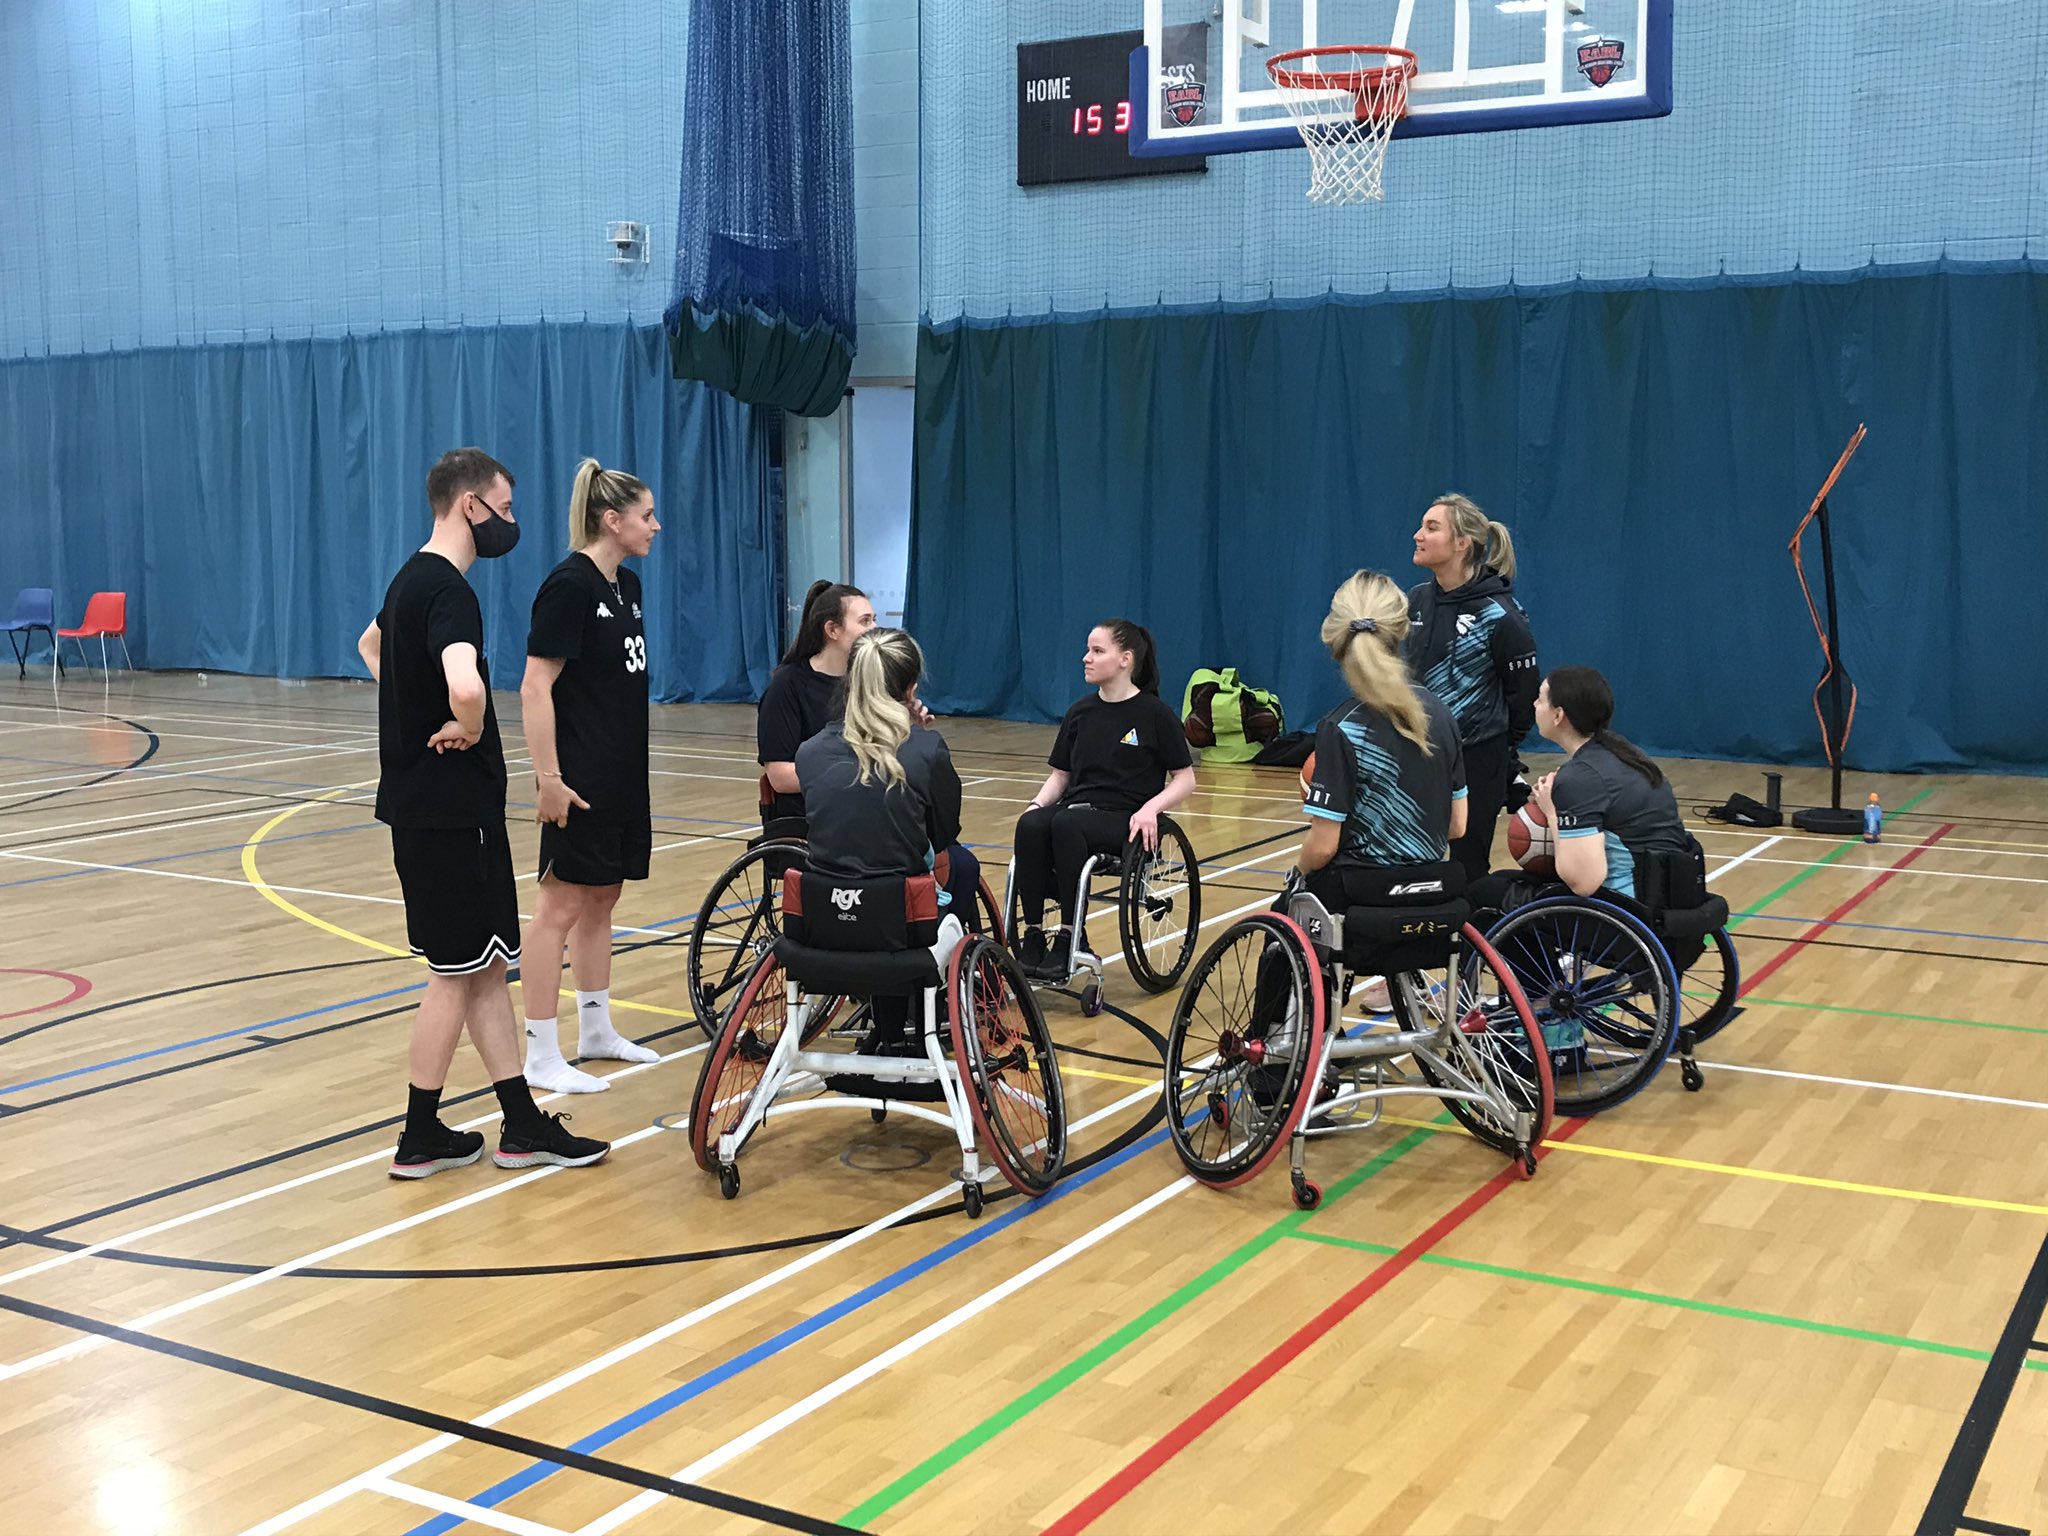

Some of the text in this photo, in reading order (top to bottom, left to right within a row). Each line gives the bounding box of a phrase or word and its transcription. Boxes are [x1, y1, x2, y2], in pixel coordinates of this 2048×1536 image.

[1026, 76, 1072, 103] HOME
[624, 635, 646, 673] 33
[1401, 921, 1448, 934] エイミー
